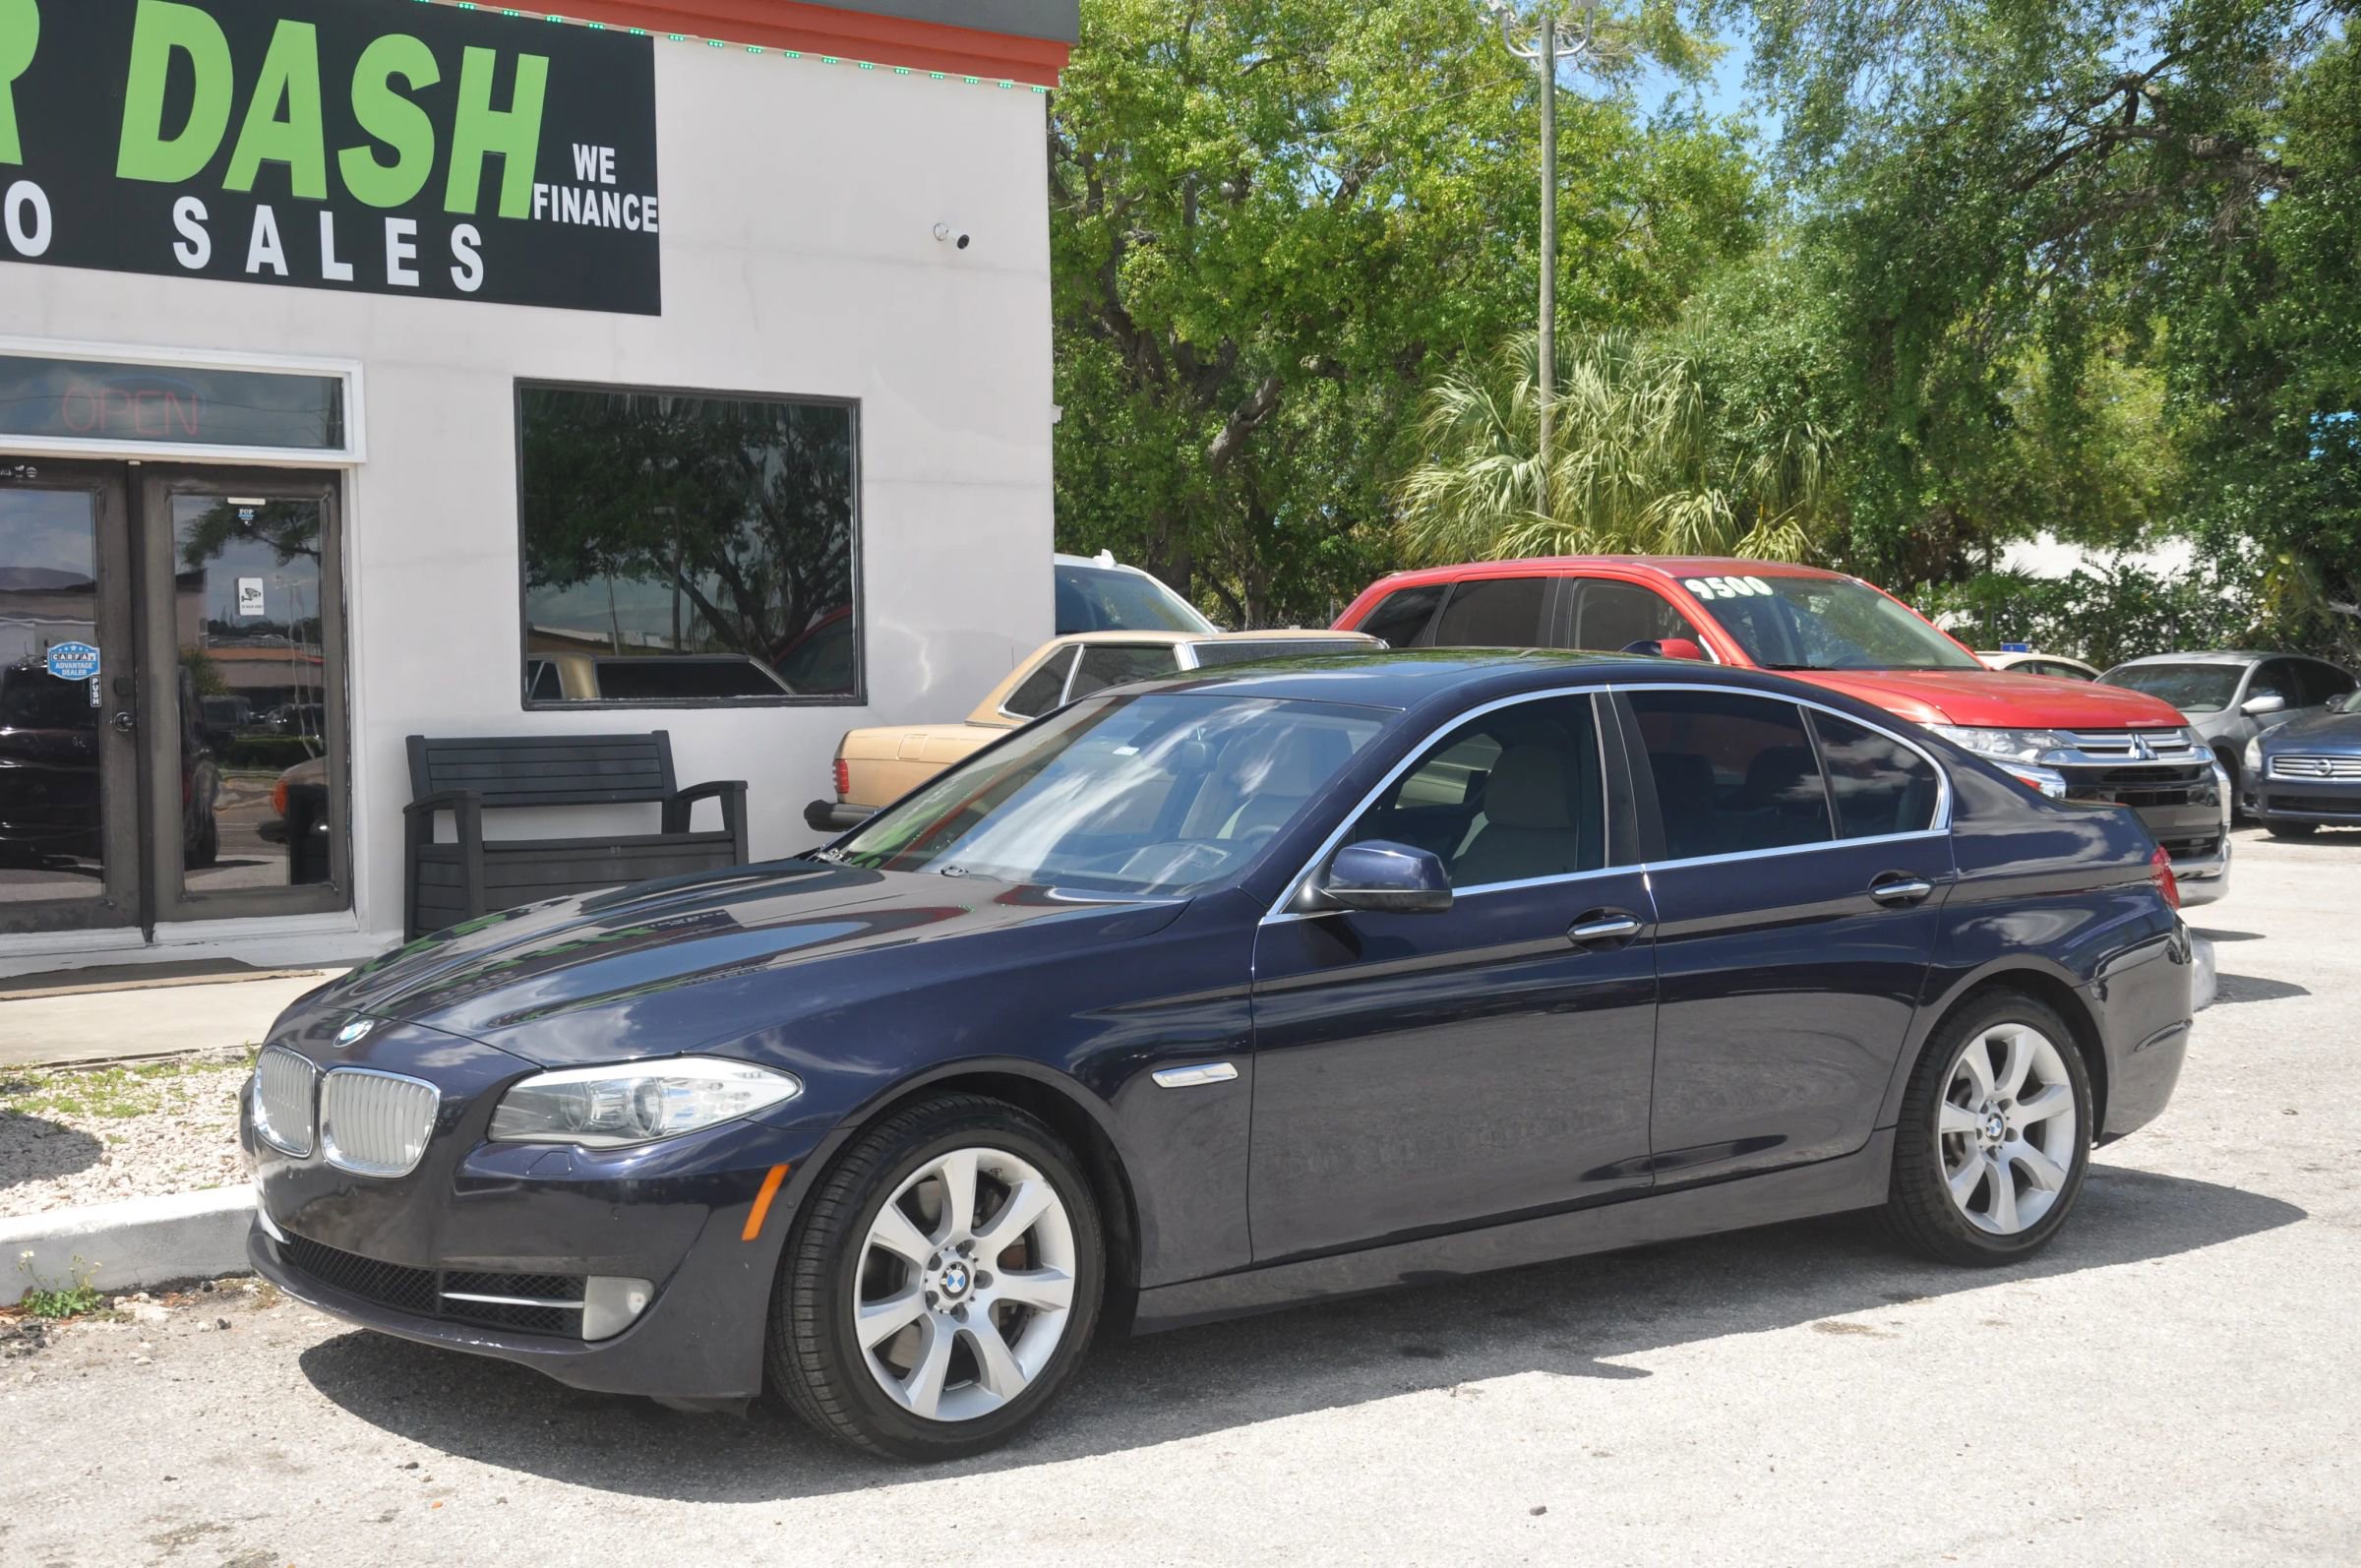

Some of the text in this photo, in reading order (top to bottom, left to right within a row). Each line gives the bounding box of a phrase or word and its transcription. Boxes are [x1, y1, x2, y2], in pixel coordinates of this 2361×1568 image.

[116, 0, 549, 219] DASH
[573, 143, 616, 184] WE
[533, 183, 658, 233] FINANCE
[172, 196, 484, 292] SALES
[62, 385, 200, 436] OPEN
[1685, 575, 1774, 600] 9500
